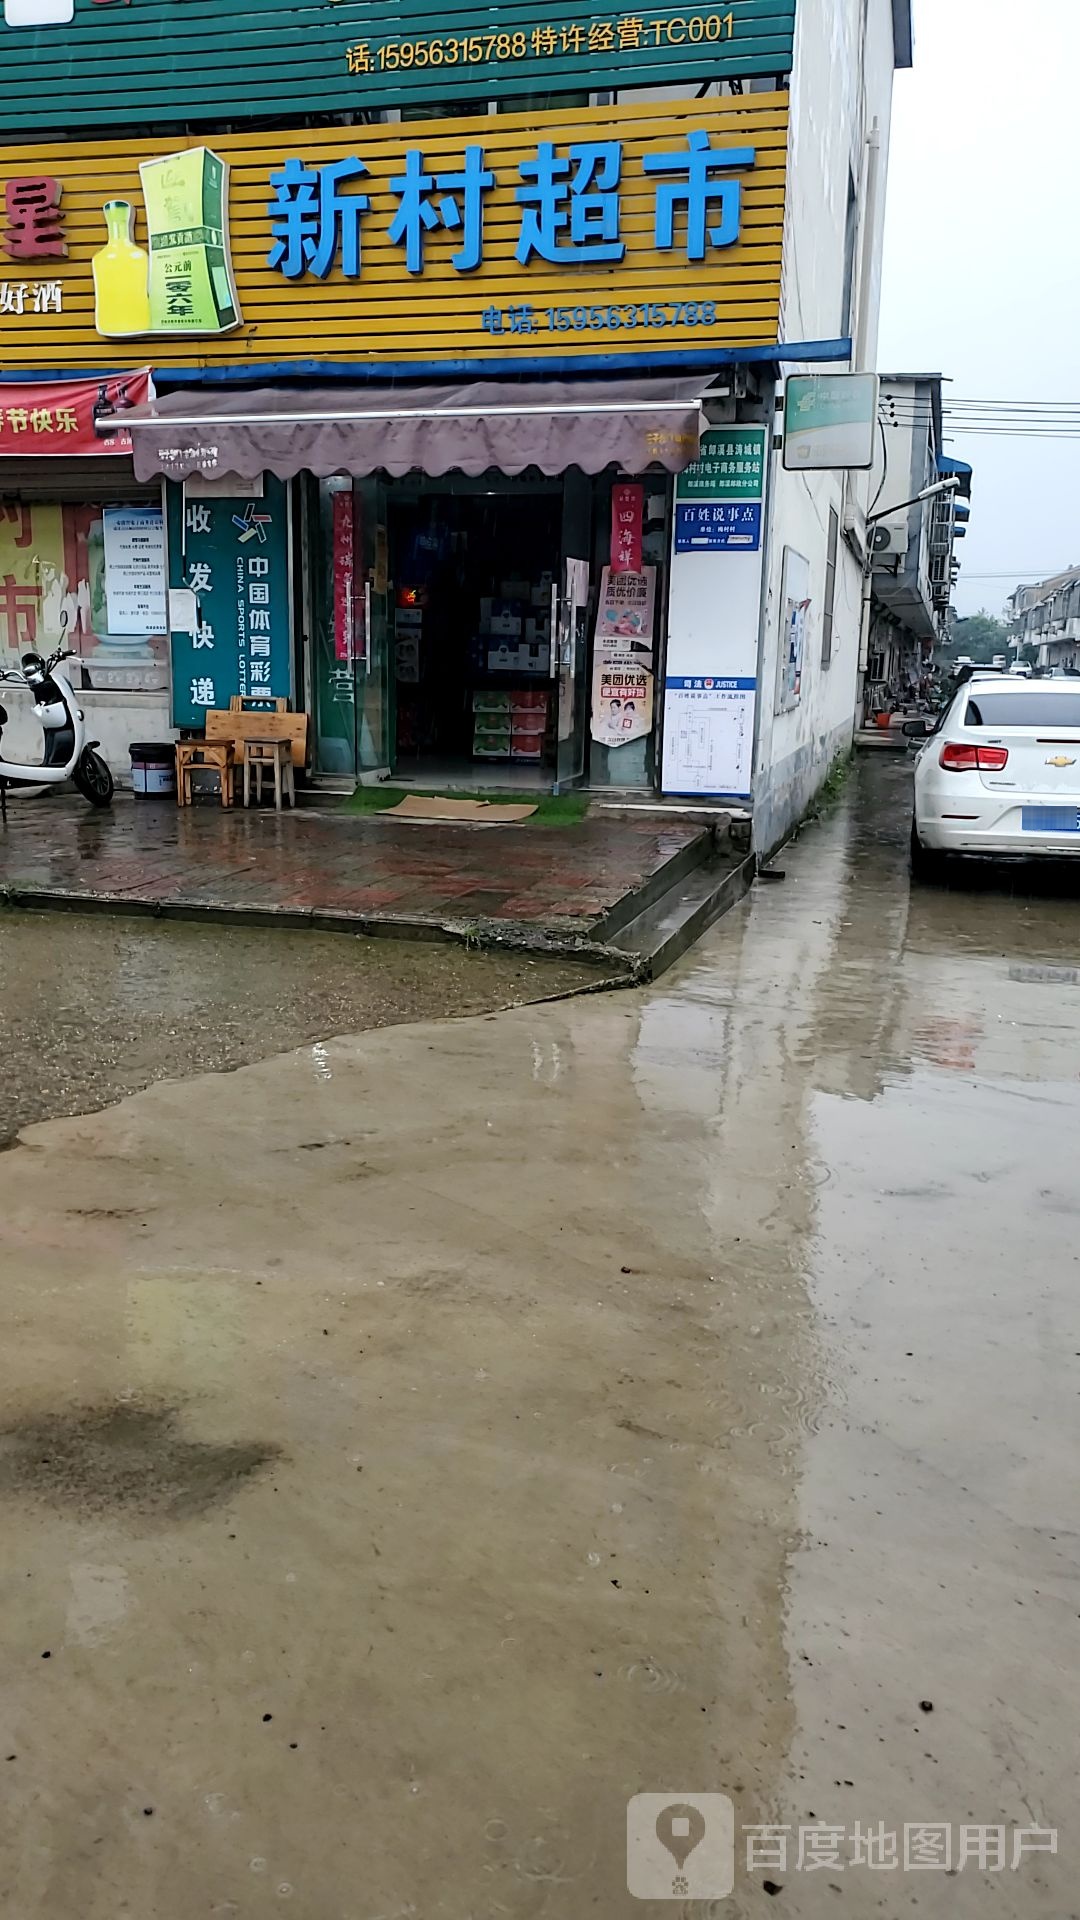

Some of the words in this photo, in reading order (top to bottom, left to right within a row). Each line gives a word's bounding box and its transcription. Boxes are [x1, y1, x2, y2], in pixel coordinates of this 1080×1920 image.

[346, 31, 526, 73] 话:15956315788
[531, 12, 735, 57] 特许经营:TC001
[267, 129, 756, 279] 新村超市
[164, 260, 192, 274] 公元前
[0, 280, 63, 314] 好酒
[0, 408, 78, 434] 节快乐
[684, 507, 754, 522] 百姓说事点
[236, 556, 244, 593] CHINA
[186, 504, 216, 706] 收发快递
[237, 599, 246, 647] SPORTS
[248, 556, 272, 708] 中国体育彩票
[239, 654, 247, 698] LOTTER
[601, 674, 648, 686] 美团优选
[684, 679, 702, 689] 司法
[715, 680, 738, 689] JUSTICE
